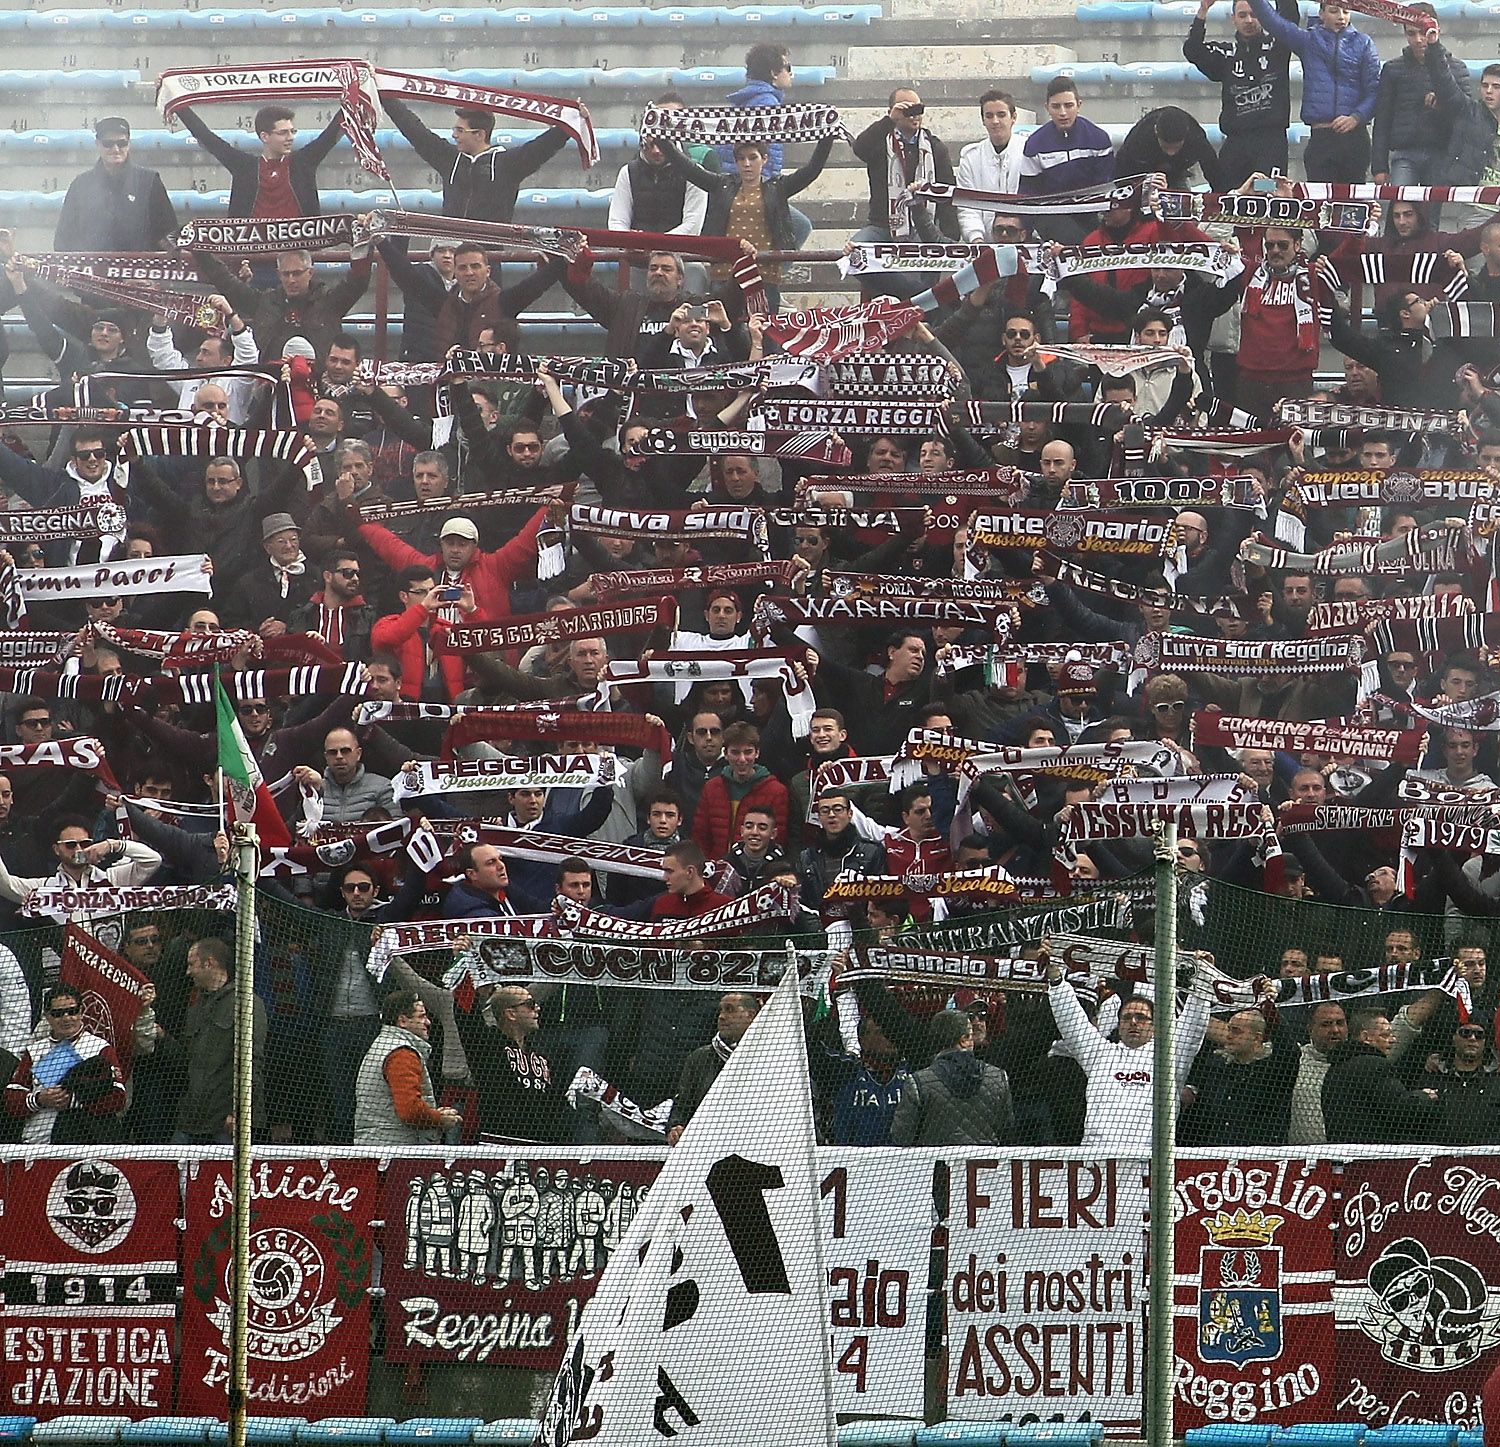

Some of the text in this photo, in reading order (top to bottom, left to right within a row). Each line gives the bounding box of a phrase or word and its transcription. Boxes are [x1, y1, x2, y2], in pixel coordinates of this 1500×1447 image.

[205, 70, 261, 87] FORZA
[402, 78, 563, 119] ALE REGGINA
[716, 104, 838, 132] AMARANTO
[198, 217, 349, 244] FORZA REGGINA
[107, 267, 198, 282] REGGINA
[882, 255, 958, 269] Passione
[1068, 251, 1207, 272] Passione Secolare
[788, 407, 856, 425] FORZA
[1280, 402, 1449, 432] REGGINA
[688, 431, 766, 453] Reggina
[1301, 469, 1389, 484] Secolare
[1302, 481, 1380, 505] nario
[10, 516, 95, 532] REGGINA
[571, 502, 671, 531] curva
[684, 506, 750, 531] sud
[972, 530, 1154, 554] Passione Secolare
[1086, 522, 1164, 543] nario
[95, 561, 177, 587] Pacci
[879, 582, 1003, 598] FORZA REGGINA
[446, 605, 658, 648] LET'S GO WARRIORS
[1163, 639, 1349, 659] Curva Sud Reggina
[1219, 717, 1399, 744] COMMANDO ULTRA
[1233, 732, 1310, 752] VILLA S.
[430, 756, 592, 779] REGGINA
[441, 772, 592, 791] Passione Secolare
[1067, 802, 1196, 841] NESSUNA
[1313, 805, 1394, 830] SEMPRE
[512, 833, 665, 865] REGGINA
[1427, 821, 1486, 850] 1979
[824, 880, 904, 899] Passione
[936, 874, 1016, 896] Secolare
[586, 900, 750, 937] FORZA REGGINA
[870, 949, 971, 977] Gennaio
[208, 1161, 361, 1219] Atiche
[966, 1159, 1117, 1229] FIERI
[1343, 1181, 1384, 1257] Per
[1404, 1161, 1433, 1214] la
[28, 1275, 152, 1303] 1914
[952, 1252, 1134, 1313] dei nostri
[399, 1296, 555, 1362] Reggina
[5, 1325, 172, 1365] ESTETICA
[1391, 1335, 1476, 1366] 1914
[955, 1322, 1135, 1398] ASSENTI
[10, 1367, 159, 1408] d'AZIONE
[202, 1346, 354, 1405] Tadizioni
[1172, 1354, 1322, 1423] Reggino
[1335, 1377, 1383, 1417] per
